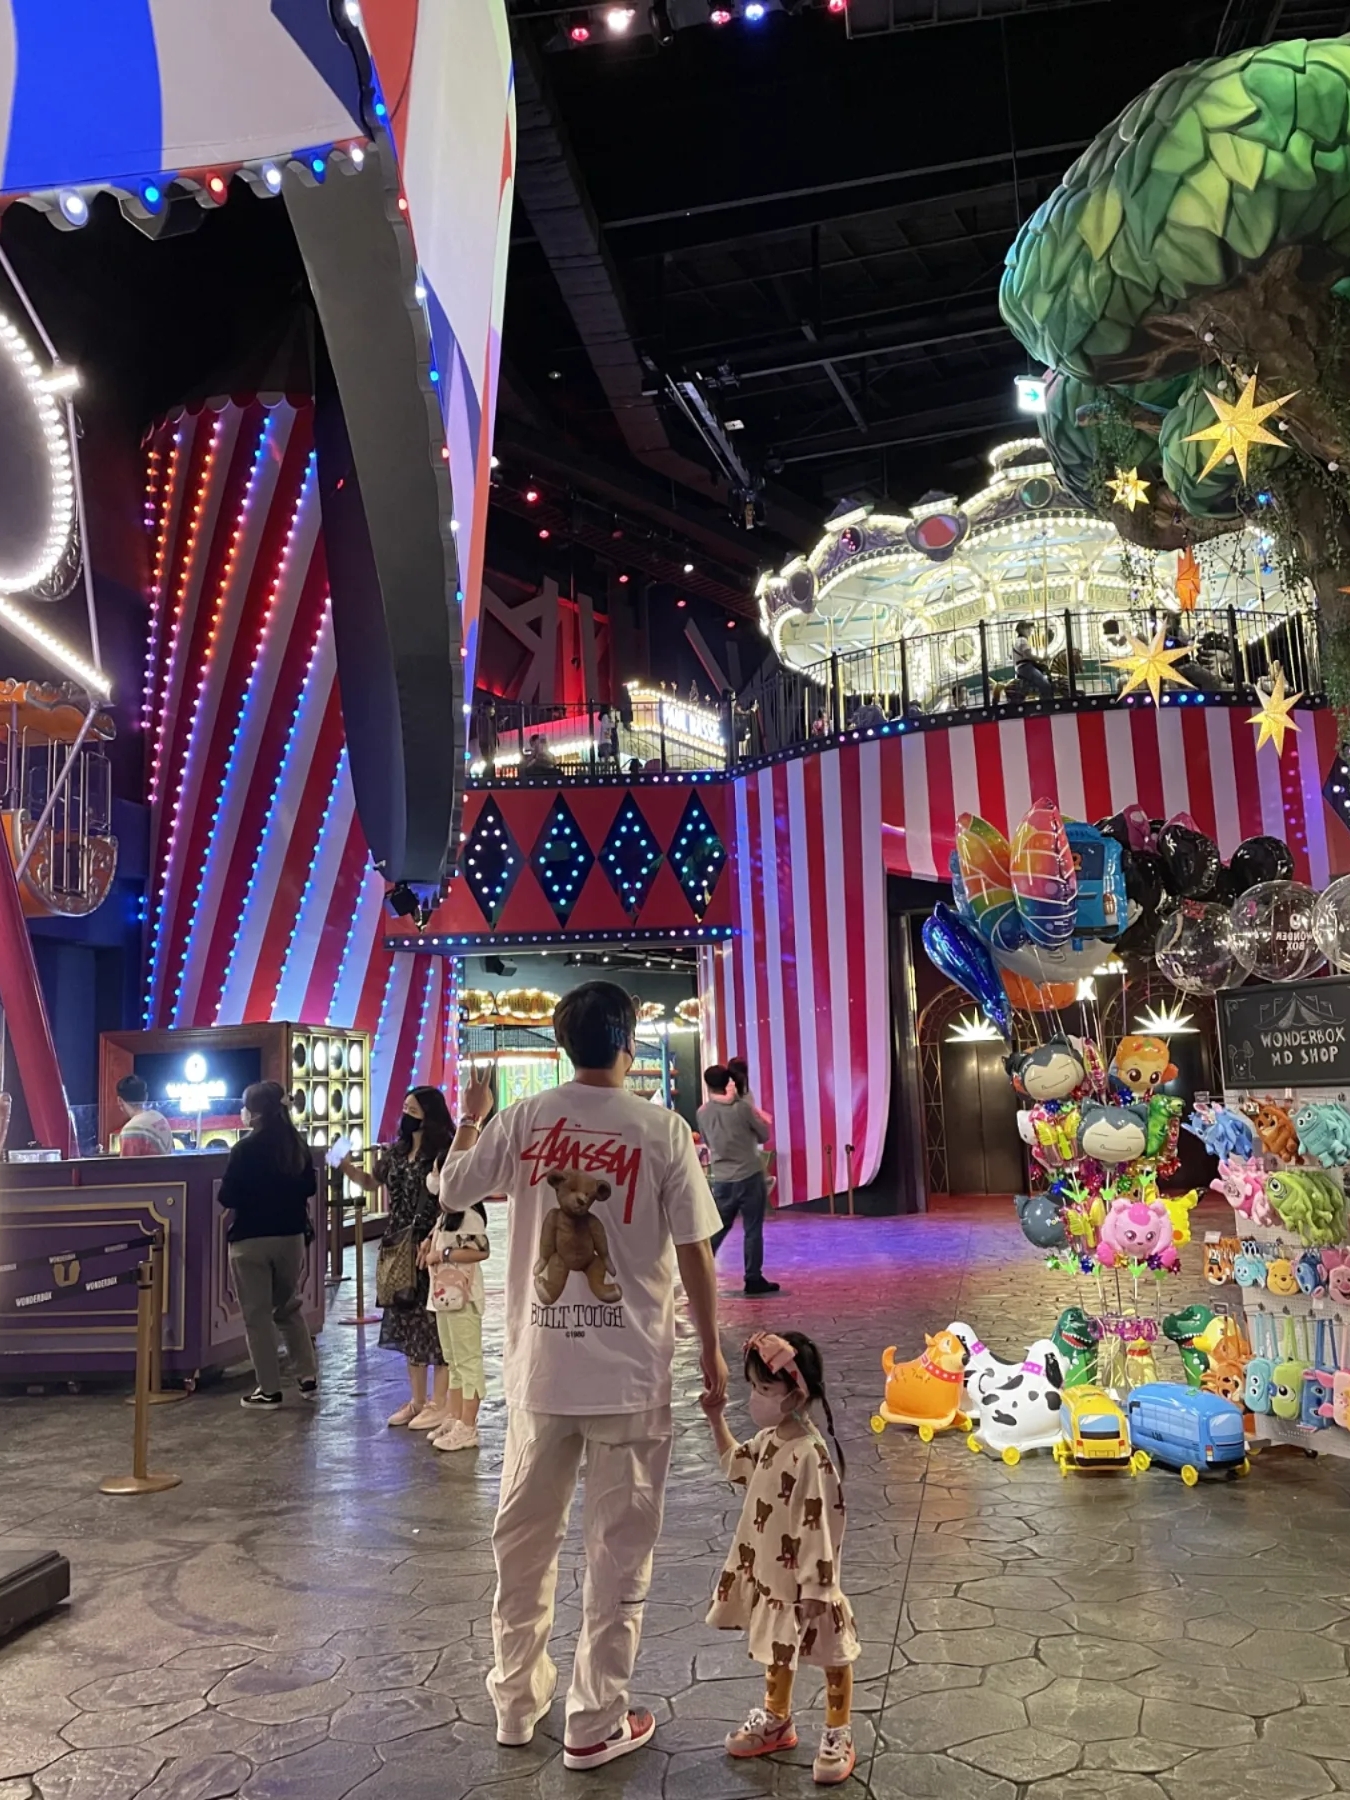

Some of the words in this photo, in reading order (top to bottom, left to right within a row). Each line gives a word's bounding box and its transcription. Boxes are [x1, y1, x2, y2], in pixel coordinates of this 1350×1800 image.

[1261, 1027, 1345, 1048] WONDERBOX
[1271, 1050, 1293, 1066] MD
[1301, 1045, 1338, 1065] SHOP
[15, 1291, 52, 1307] WONDERBOX
[85, 1276, 117, 1291] WONDERBOX
[531, 1302, 569, 1329] BUILT
[573, 1304, 626, 1328] TOUGH
